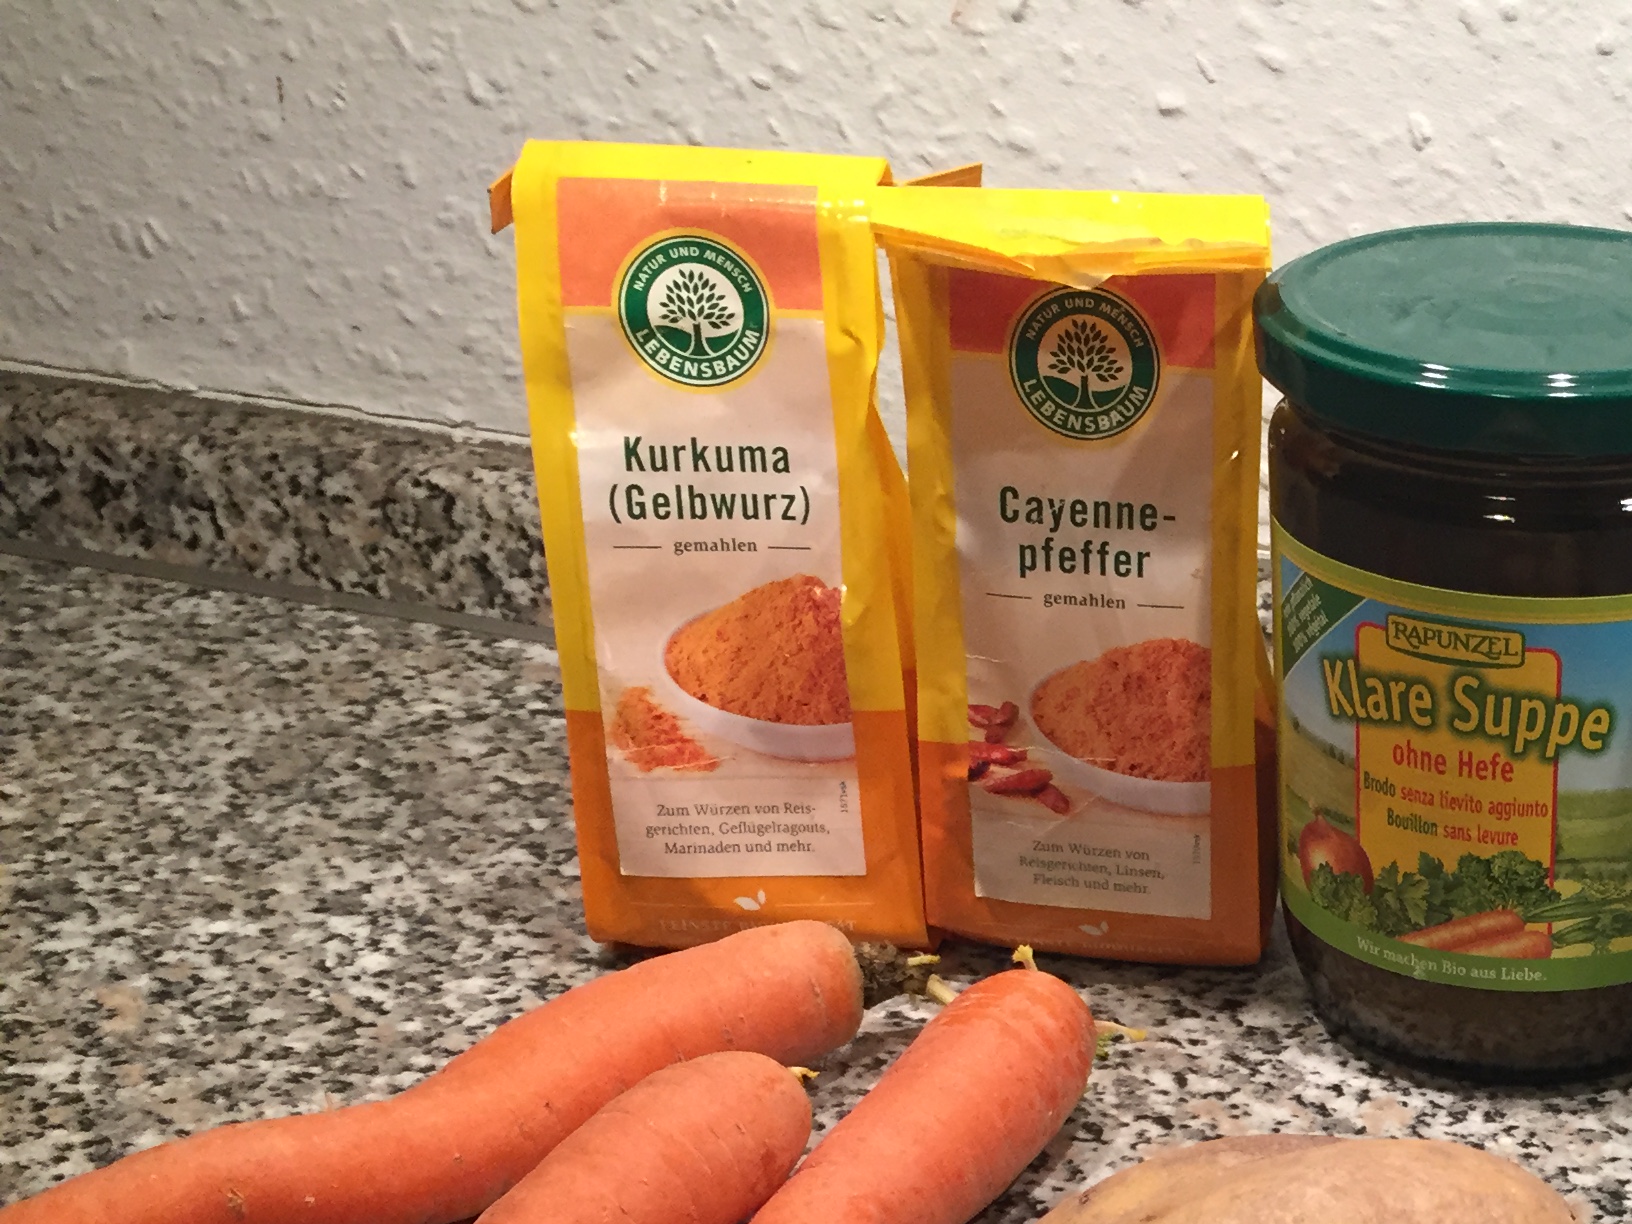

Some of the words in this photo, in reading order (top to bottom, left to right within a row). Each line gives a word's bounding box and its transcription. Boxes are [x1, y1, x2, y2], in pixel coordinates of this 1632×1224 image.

[633, 252, 667, 292] NATUR
[669, 246, 700, 258] UND
[703, 249, 753, 294] MENSCH
[1026, 303, 1061, 341] NATUR
[1064, 297, 1095, 309] UND
[1098, 302, 1145, 349] MENSCH
[635, 328, 761, 379] LEBENSBAUM
[1023, 378, 1149, 434] LEBENSBAUM
[623, 435, 792, 474] Kurkuma
[608, 483, 812, 526] (Gelbwurz)
[999, 485, 1177, 534] Cayenne-
[673, 537, 759, 556] gemahlen
[1018, 536, 1151, 579] pfeffer
[1043, 591, 1127, 610] gemahlen
[1391, 618, 1520, 661] RAPUNZEL
[1321, 656, 1433, 726] Klare
[1453, 675, 1612, 758] Suppe
[1392, 739, 1447, 775] ohne
[1458, 750, 1515, 784] Hefe
[656, 804, 690, 817] Zum
[694, 803, 751, 816] Würzen
[755, 804, 780, 815] von
[783, 802, 816, 815] Reis-
[1363, 770, 1396, 798] Brodo
[1400, 786, 1435, 807] senza
[1488, 797, 1549, 821] aggiunto
[646, 823, 715, 839] gerichten,
[719, 820, 831, 837] Geflügelragouts,
[664, 841, 741, 855] Marinaden
[745, 840, 772, 853] und
[776, 839, 816, 853] mehr.
[1387, 807, 1438, 837] Bouillon
[1443, 823, 1472, 843] sans
[1477, 824, 1519, 846] levure
[1019, 855, 1112, 876] Reisgerichten,
[1116, 864, 1166, 880] Linsen,
[1032, 840, 1064, 853] Zum
[1068, 842, 1122, 859] Würzen
[1125, 850, 1150, 861] von
[1032, 873, 1080, 888] Fleisch
[1083, 878, 1110, 891] und
[1356, 935, 1382, 958] Wir
[1382, 948, 1438, 973] machen
[1441, 959, 1467, 978] Bio
[1470, 967, 1497, 981] aus
[1500, 967, 1548, 983] Liebe.
